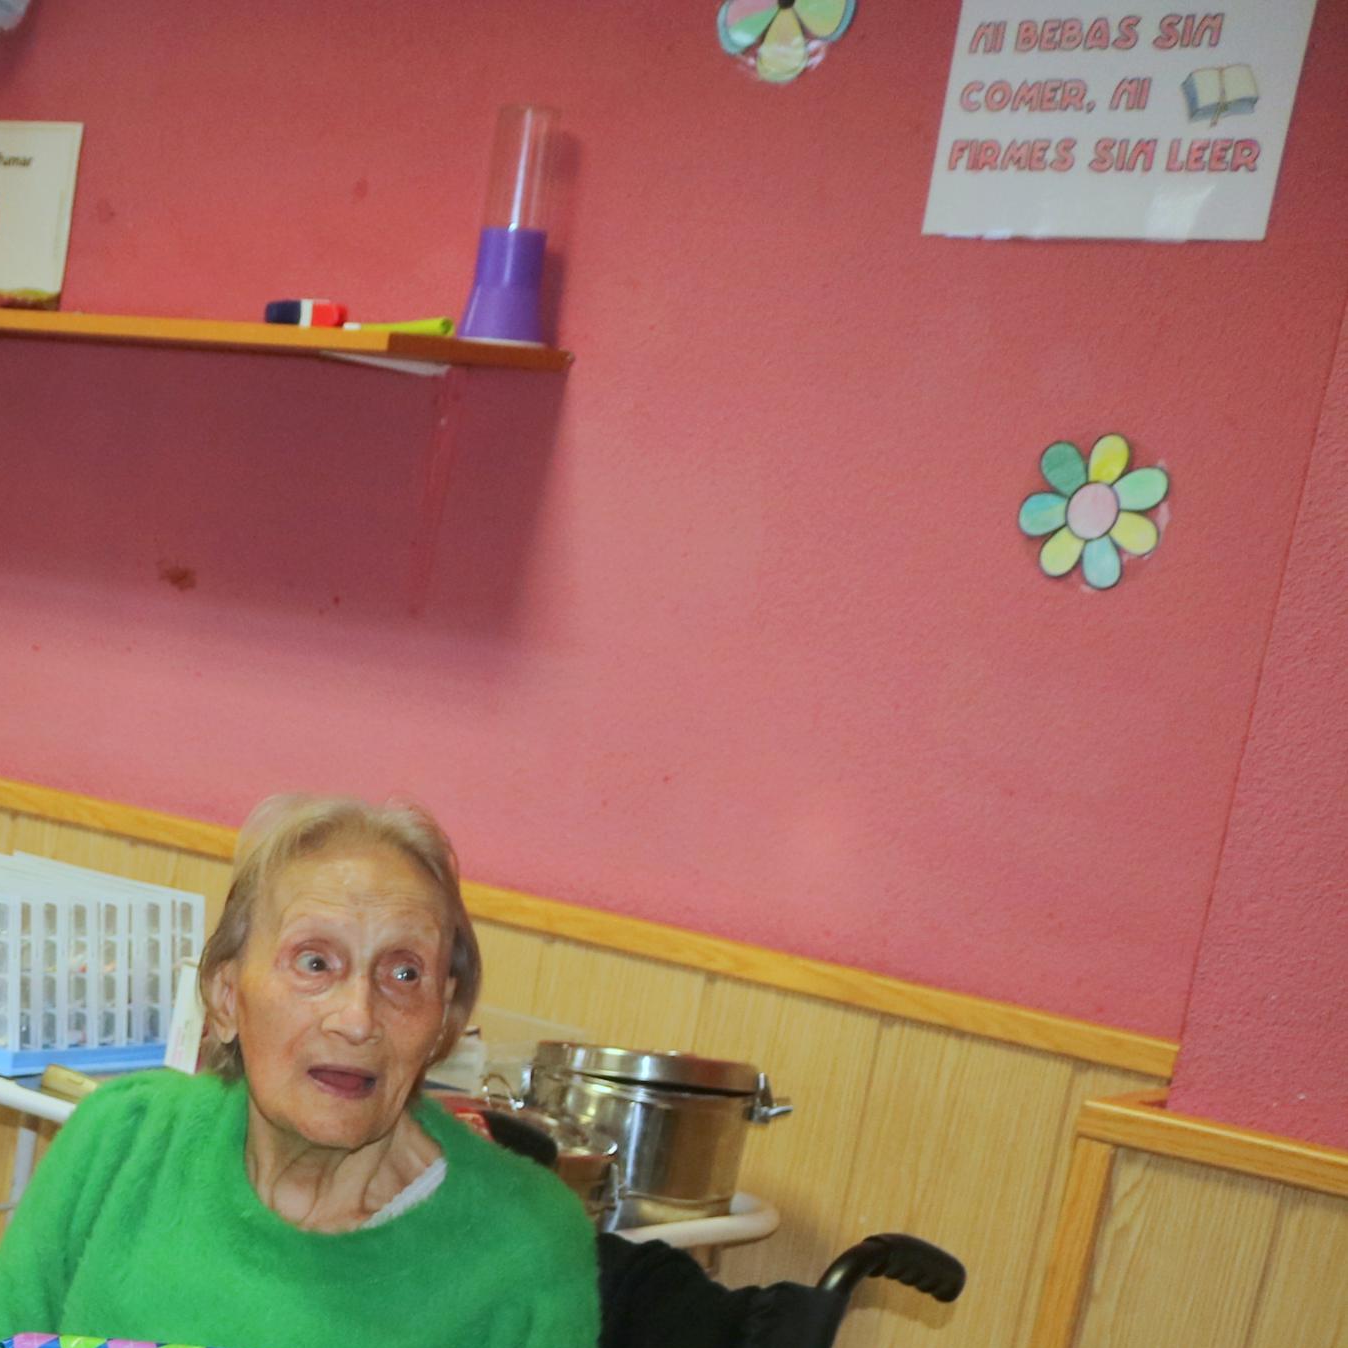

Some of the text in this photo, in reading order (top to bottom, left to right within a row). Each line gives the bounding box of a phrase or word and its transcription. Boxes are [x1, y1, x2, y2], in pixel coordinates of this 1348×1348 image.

[969, 13, 1225, 54] NI BEBAS SIN
[960, 77, 1152, 114] COMER, NI
[948, 137, 1263, 172] FIRMES SIN LEER
